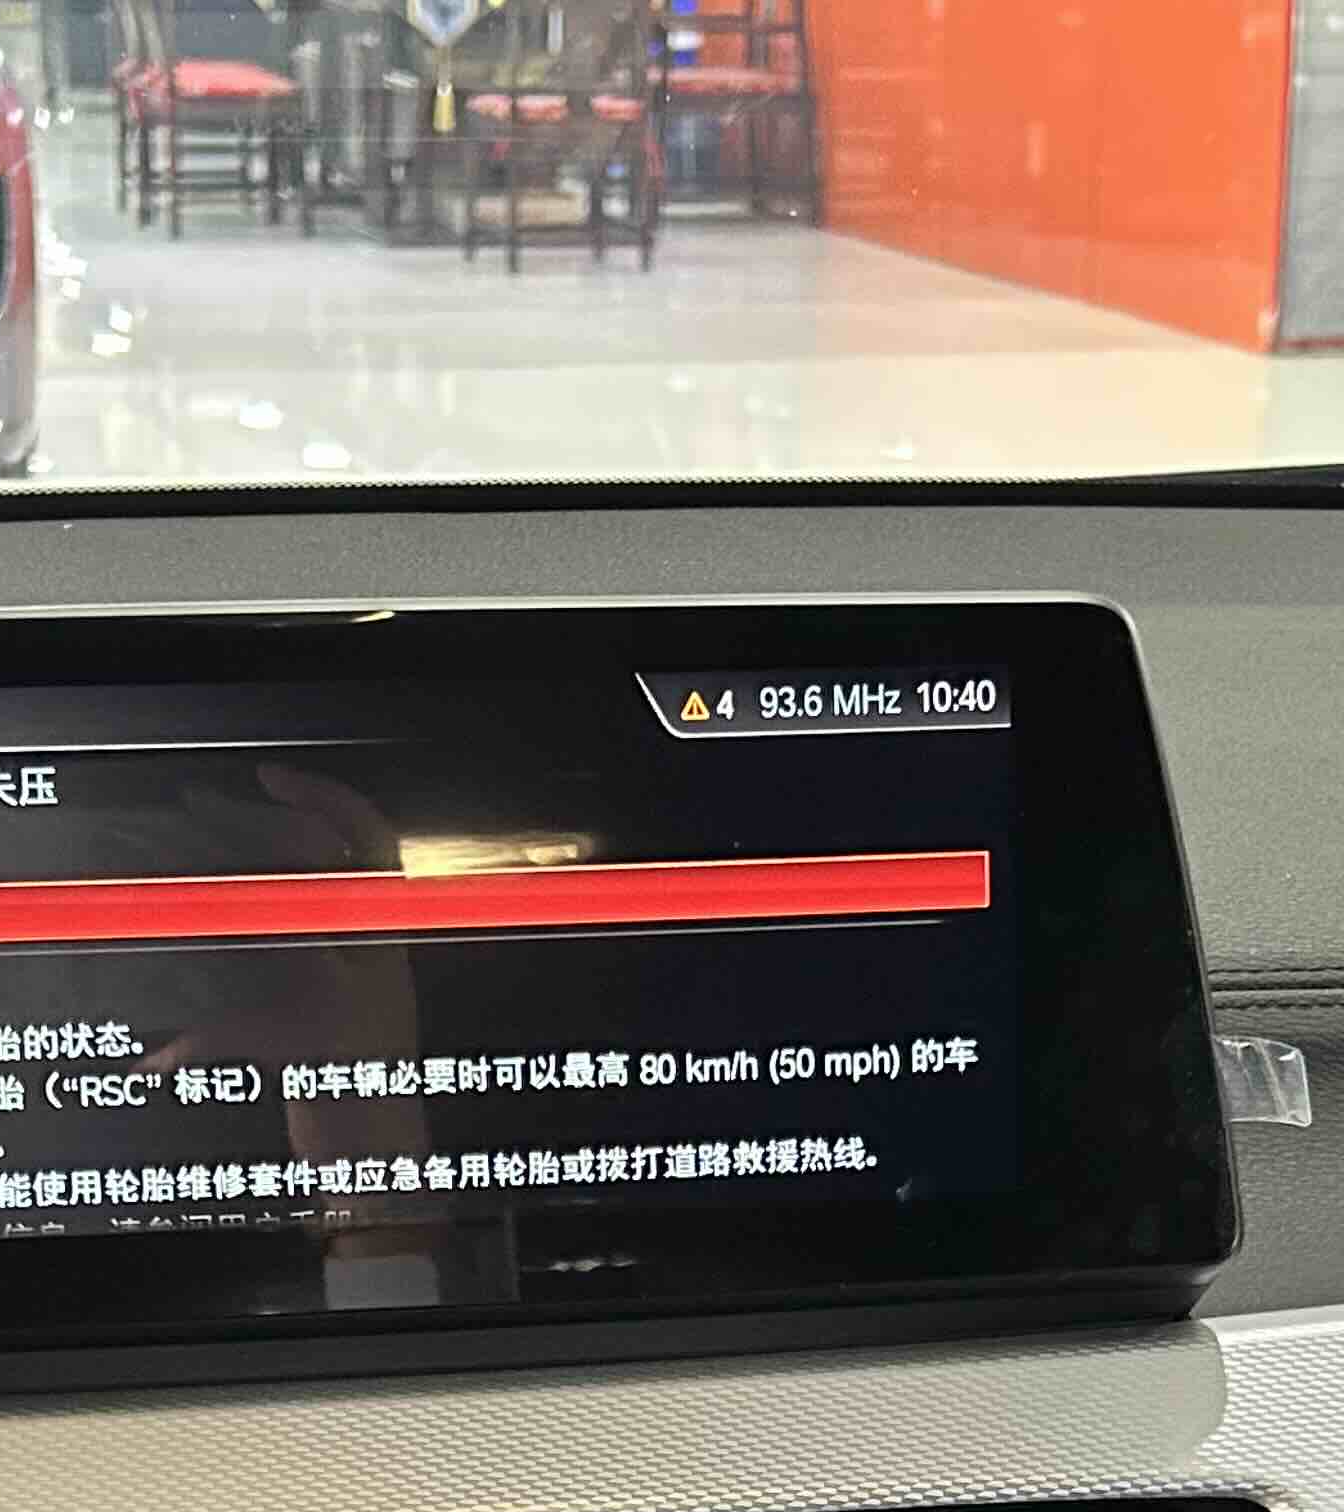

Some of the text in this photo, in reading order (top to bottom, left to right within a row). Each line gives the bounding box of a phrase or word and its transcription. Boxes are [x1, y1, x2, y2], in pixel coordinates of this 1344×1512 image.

[716, 679, 997, 720] 4 93.6 MHz 10:40
[639, 1053, 677, 1086] 80
[685, 1050, 759, 1083] km/h
[769, 1047, 816, 1085] (50
[824, 1043, 901, 1083] mph)
[911, 1036, 979, 1073] 的车
